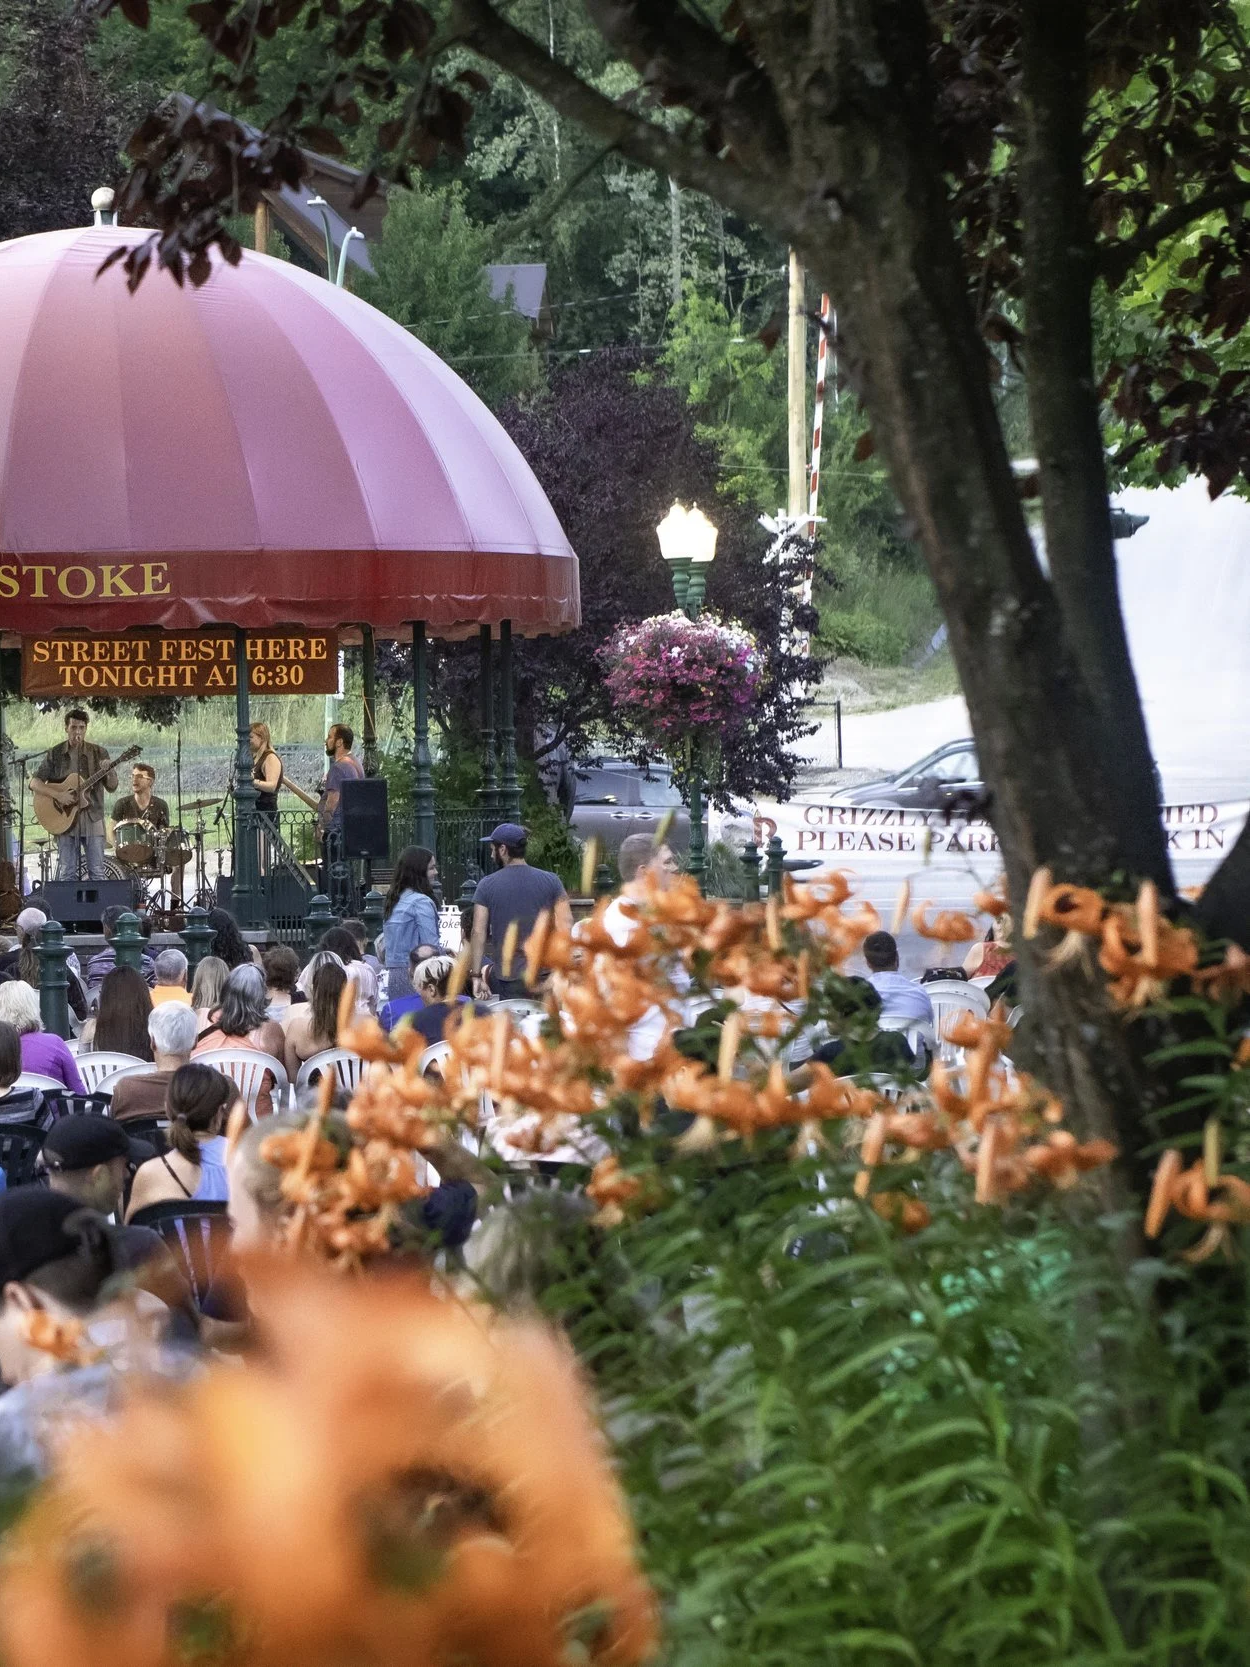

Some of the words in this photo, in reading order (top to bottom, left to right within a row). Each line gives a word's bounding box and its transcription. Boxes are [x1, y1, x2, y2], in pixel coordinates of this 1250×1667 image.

[33, 641, 150, 663] STREET
[159, 639, 236, 662] FEST
[245, 638, 328, 661] HERE
[58, 665, 198, 688] TONIGHT
[251, 664, 304, 686] 6:30
[803, 805, 933, 828] GRIZZLY
[796, 830, 916, 852] PLEASE
[1193, 829, 1225, 849] IN
